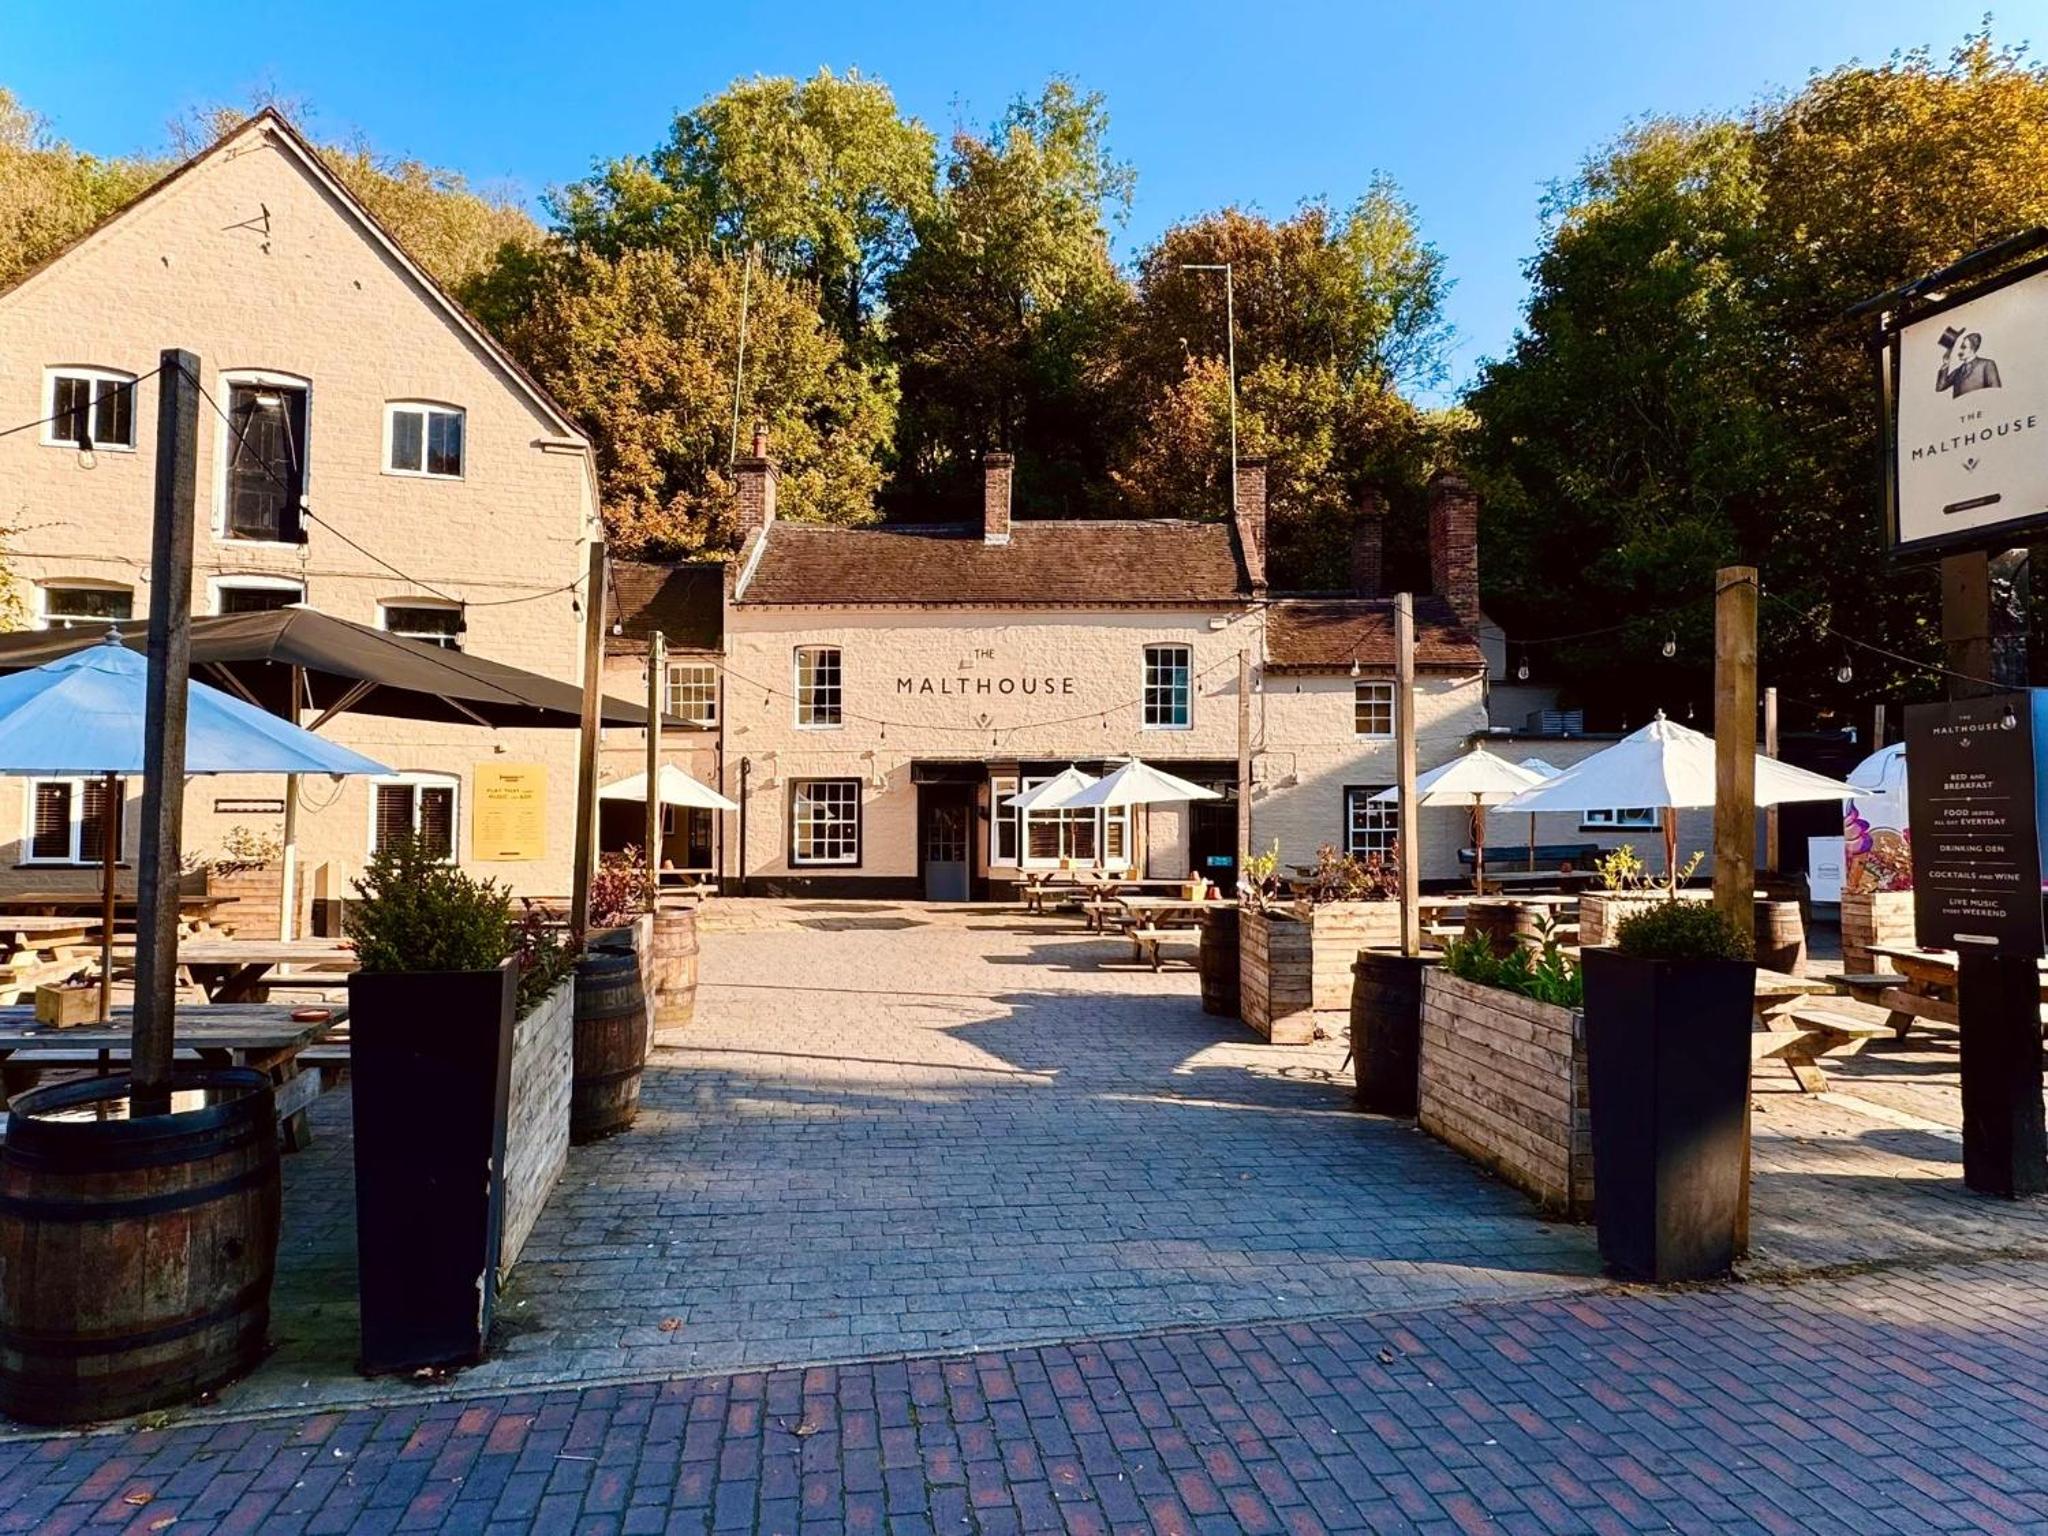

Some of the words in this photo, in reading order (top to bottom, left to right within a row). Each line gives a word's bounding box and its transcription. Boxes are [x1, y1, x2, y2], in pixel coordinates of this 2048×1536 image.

[1959, 411, 1983, 424] THE
[1911, 415, 2038, 461] MALTHOUSE
[974, 649, 995, 659] THE
[897, 677, 1074, 694] MALTHOUSE
[1933, 722, 1998, 735] MALTHOUSE
[1943, 781, 1993, 790] BREAKFAST
[1929, 871, 1977, 879] COCKTAILS
[1962, 909, 2007, 917] WEEKEND
